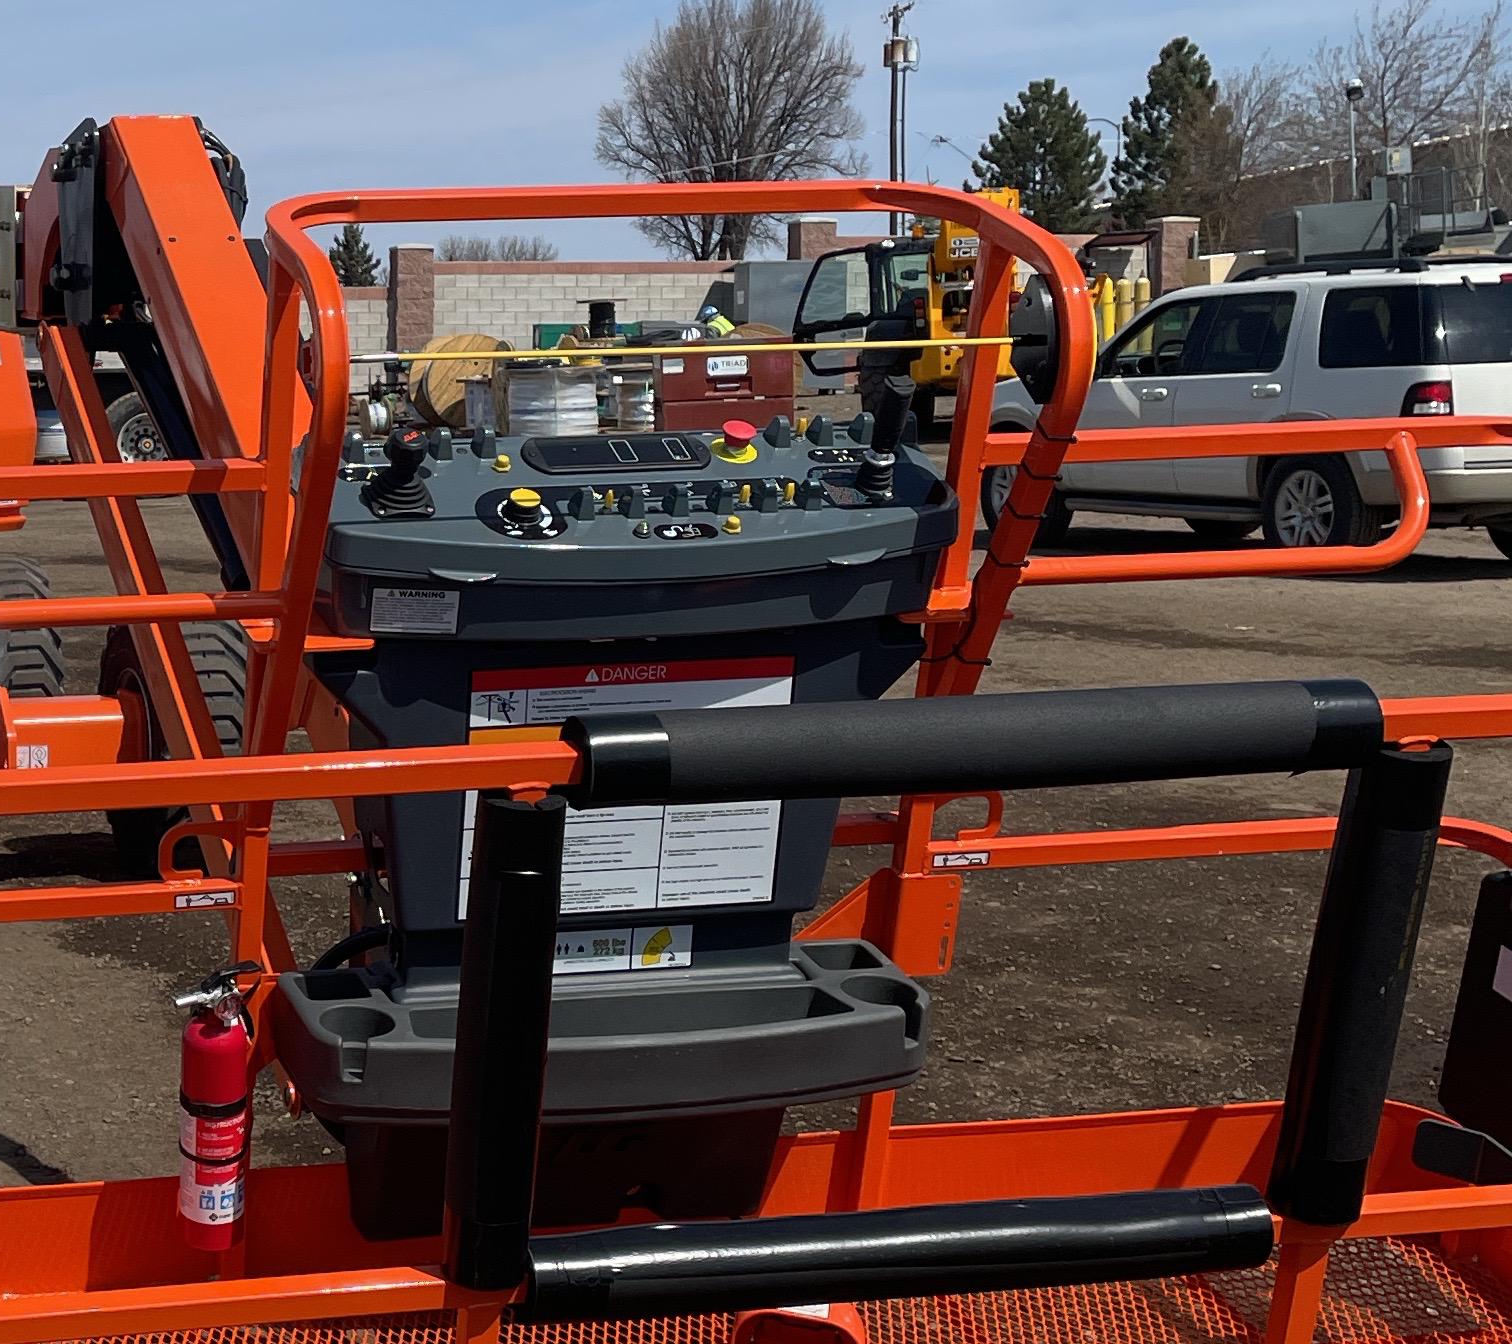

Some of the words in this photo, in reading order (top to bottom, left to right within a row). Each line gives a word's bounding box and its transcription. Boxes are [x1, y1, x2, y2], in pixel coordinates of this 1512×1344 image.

[721, 360, 746, 368] TRIAD
[398, 589, 446, 599] WARNING
[601, 665, 667, 682] DANGER
